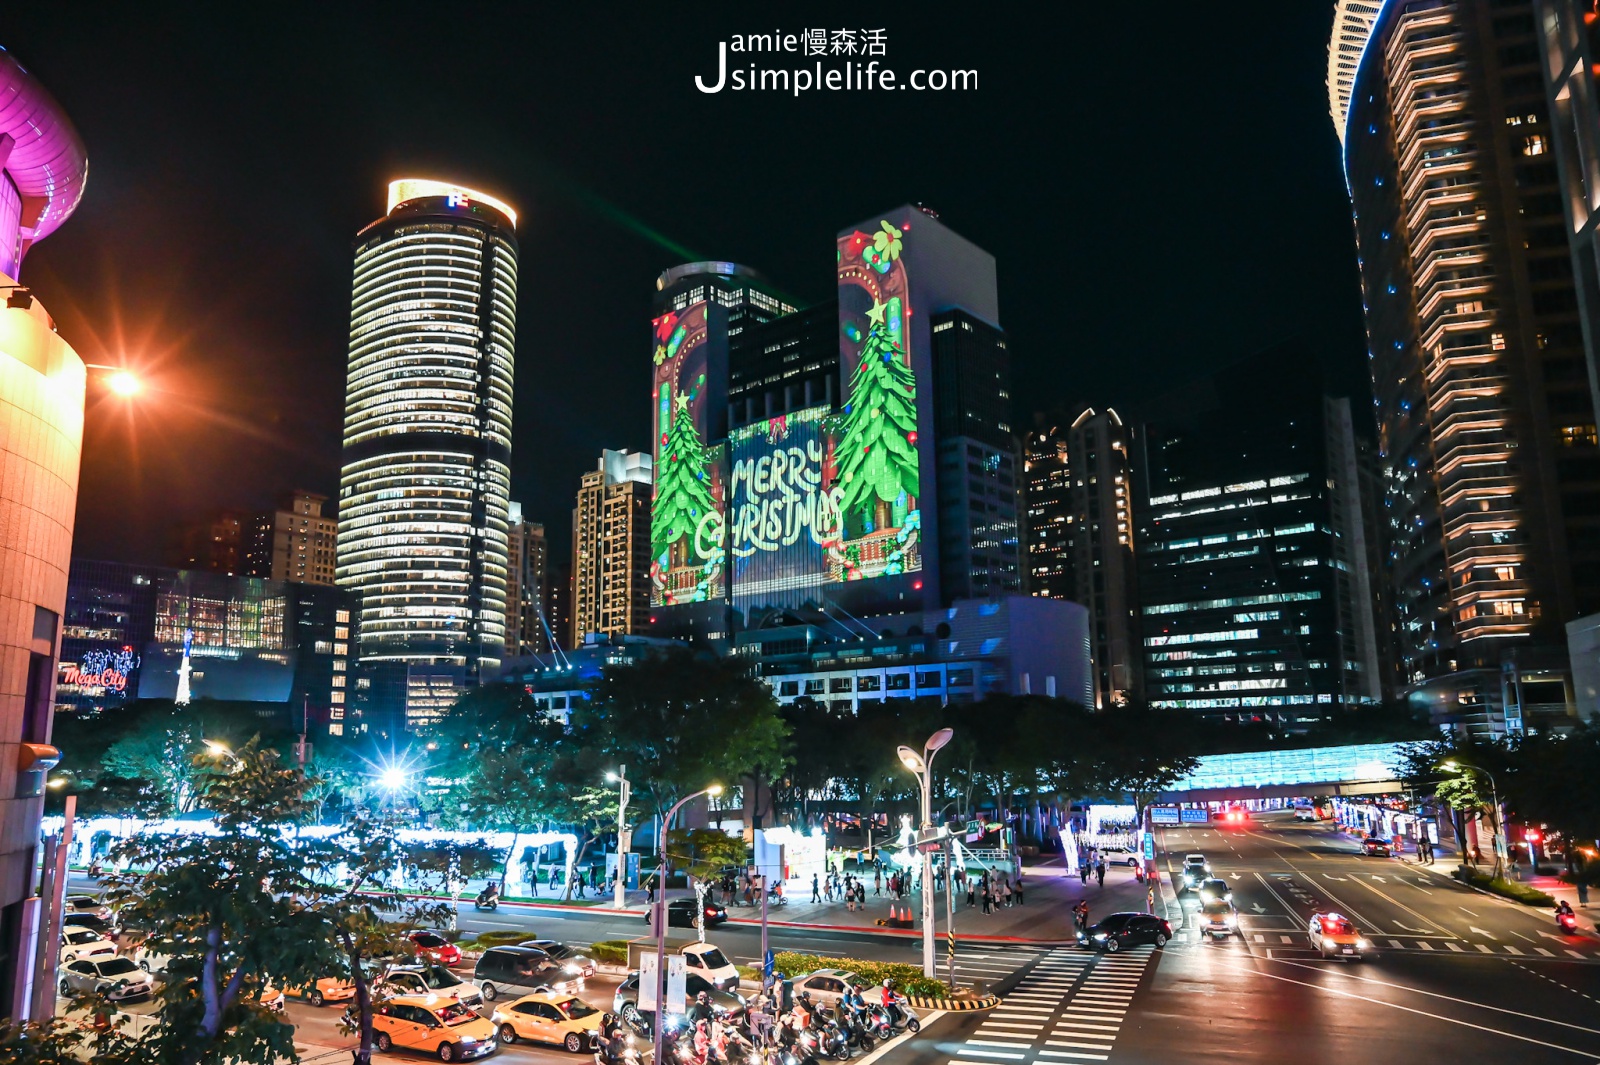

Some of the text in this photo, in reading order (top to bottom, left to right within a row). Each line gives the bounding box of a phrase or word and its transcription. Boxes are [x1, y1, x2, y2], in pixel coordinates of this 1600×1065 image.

[723, 439, 823, 504] MERRY
[694, 487, 847, 560] CHRISTMAS
[64, 667, 126, 690] Mega City
